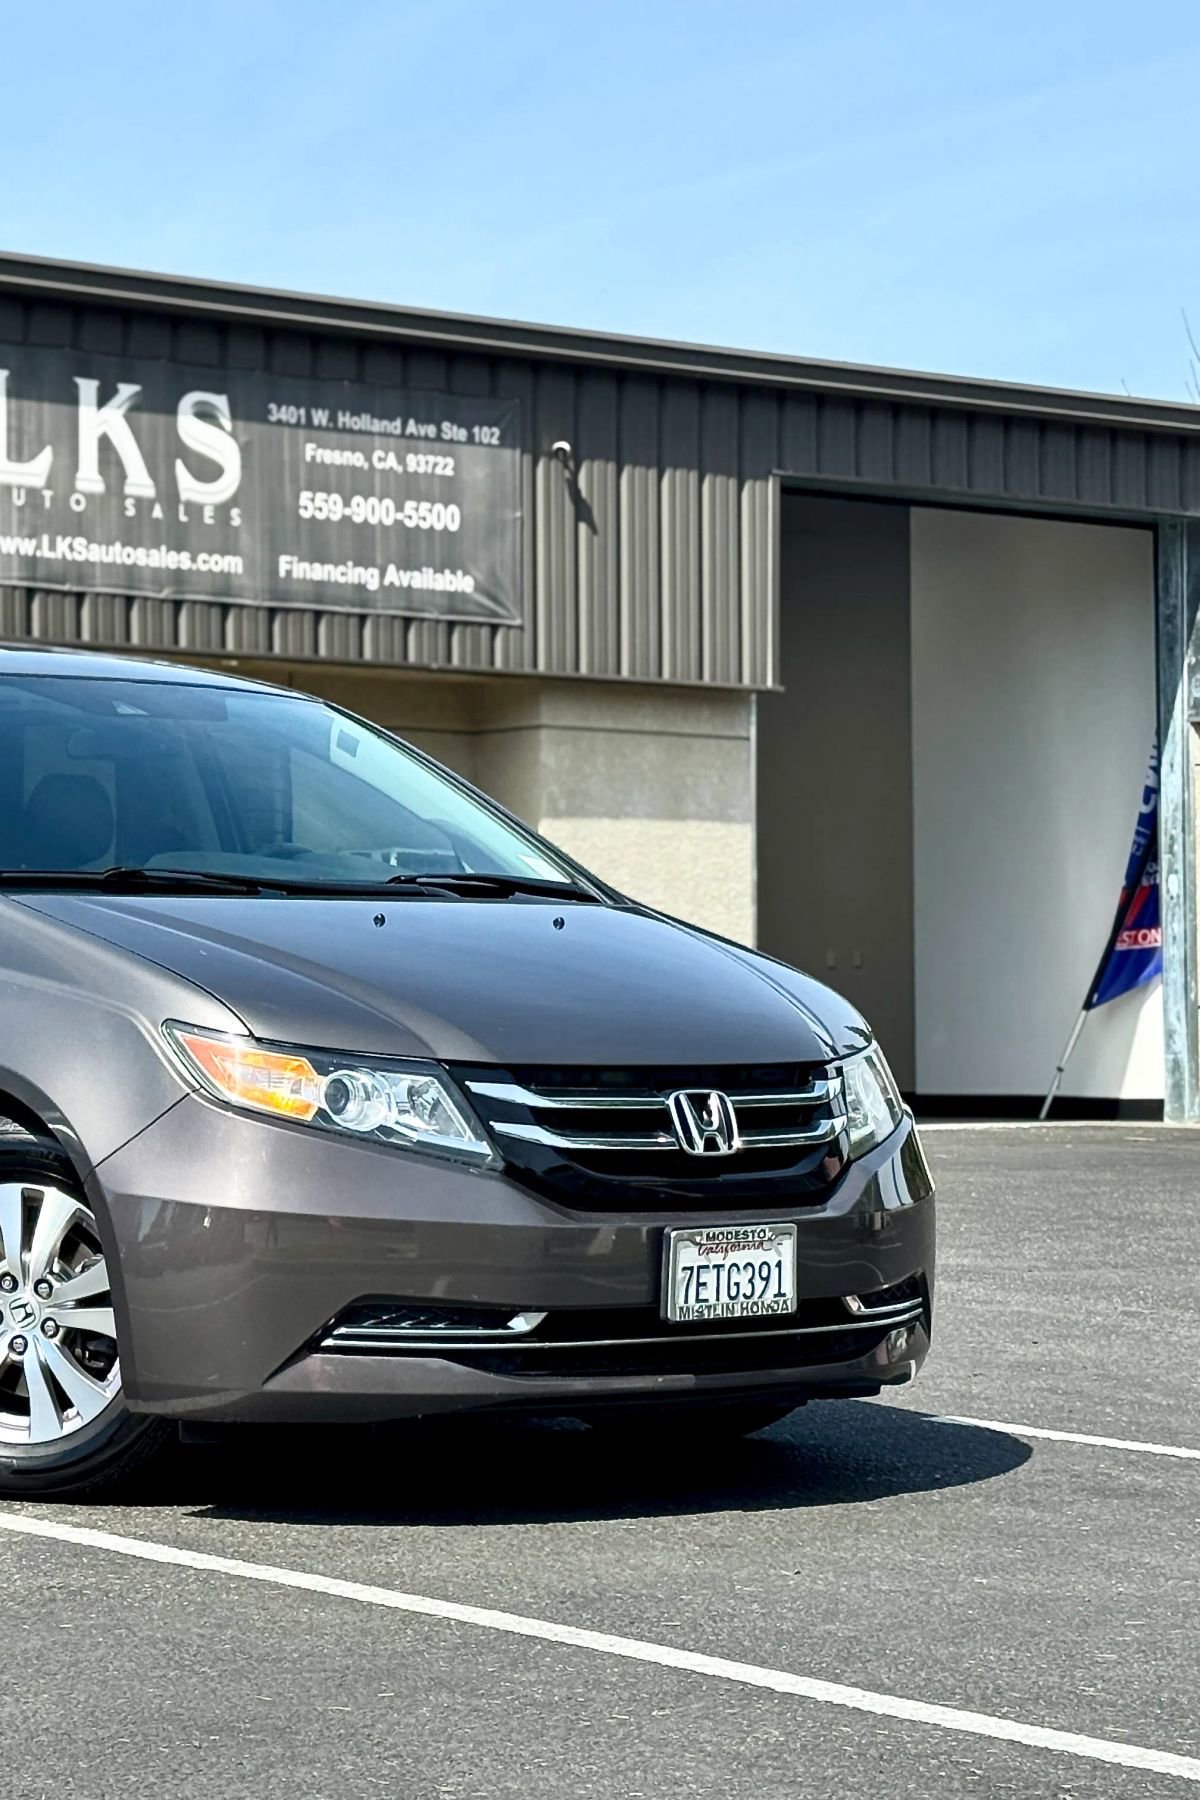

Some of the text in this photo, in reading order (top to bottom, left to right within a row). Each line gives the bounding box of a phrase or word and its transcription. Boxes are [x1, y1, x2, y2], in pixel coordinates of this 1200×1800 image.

[267, 403, 500, 445] 3401 W. Holland Ave Ste 102
[304, 443, 455, 476] Fresno, CA, 93722
[124, 497, 242, 527] SALES
[298, 490, 461, 532] 559-900-5500
[278, 554, 475, 593] Financing Available
[1114, 928, 1162, 946] STON
[698, 1241, 772, 1260] California
[705, 1229, 767, 1242] MODESTO
[680, 1259, 787, 1305] 7ETG391
[678, 1298, 789, 1320] MISTLIN HONDA
